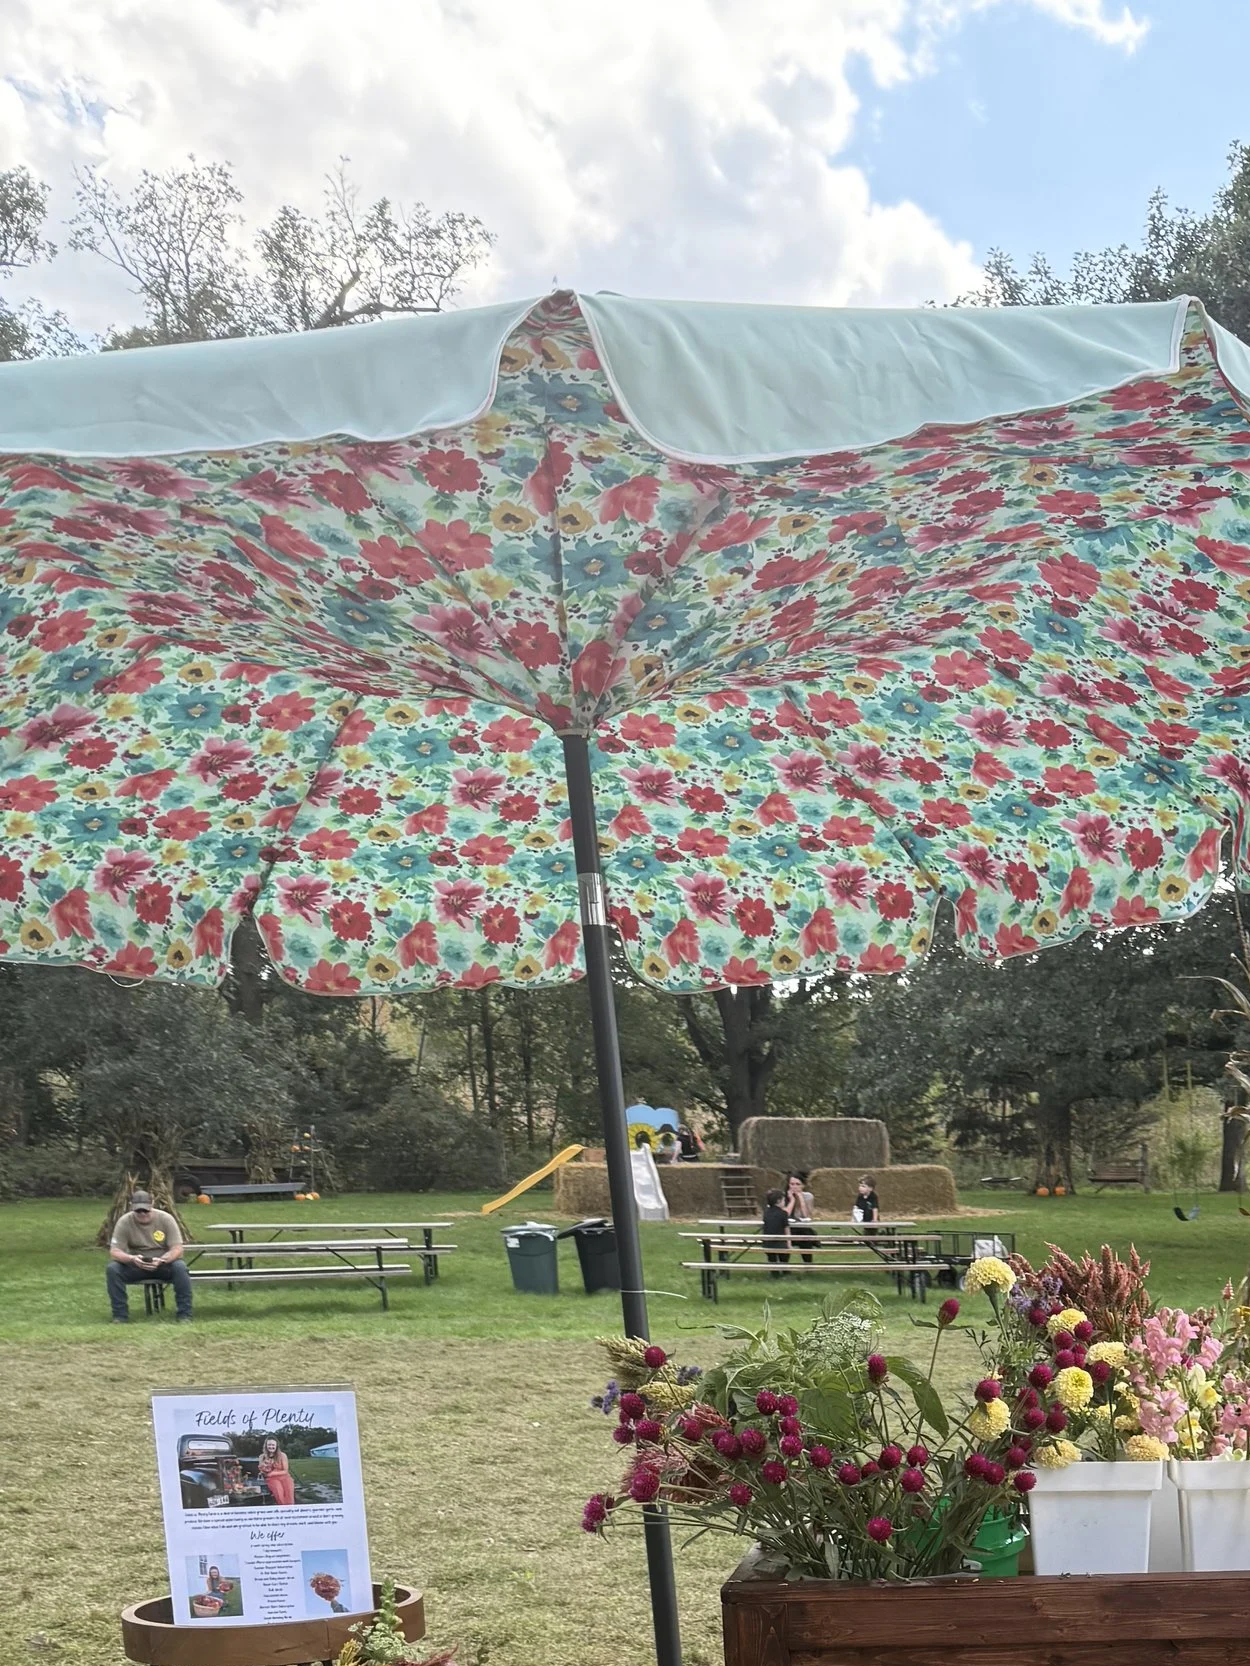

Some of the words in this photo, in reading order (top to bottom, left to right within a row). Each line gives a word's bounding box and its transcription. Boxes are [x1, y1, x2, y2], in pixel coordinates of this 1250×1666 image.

[195, 1408, 237, 1428] Fields
[242, 1410, 258, 1429] of
[261, 1407, 315, 1428] Plenty
[250, 1531, 265, 1540] We
[266, 1531, 286, 1541] offer
